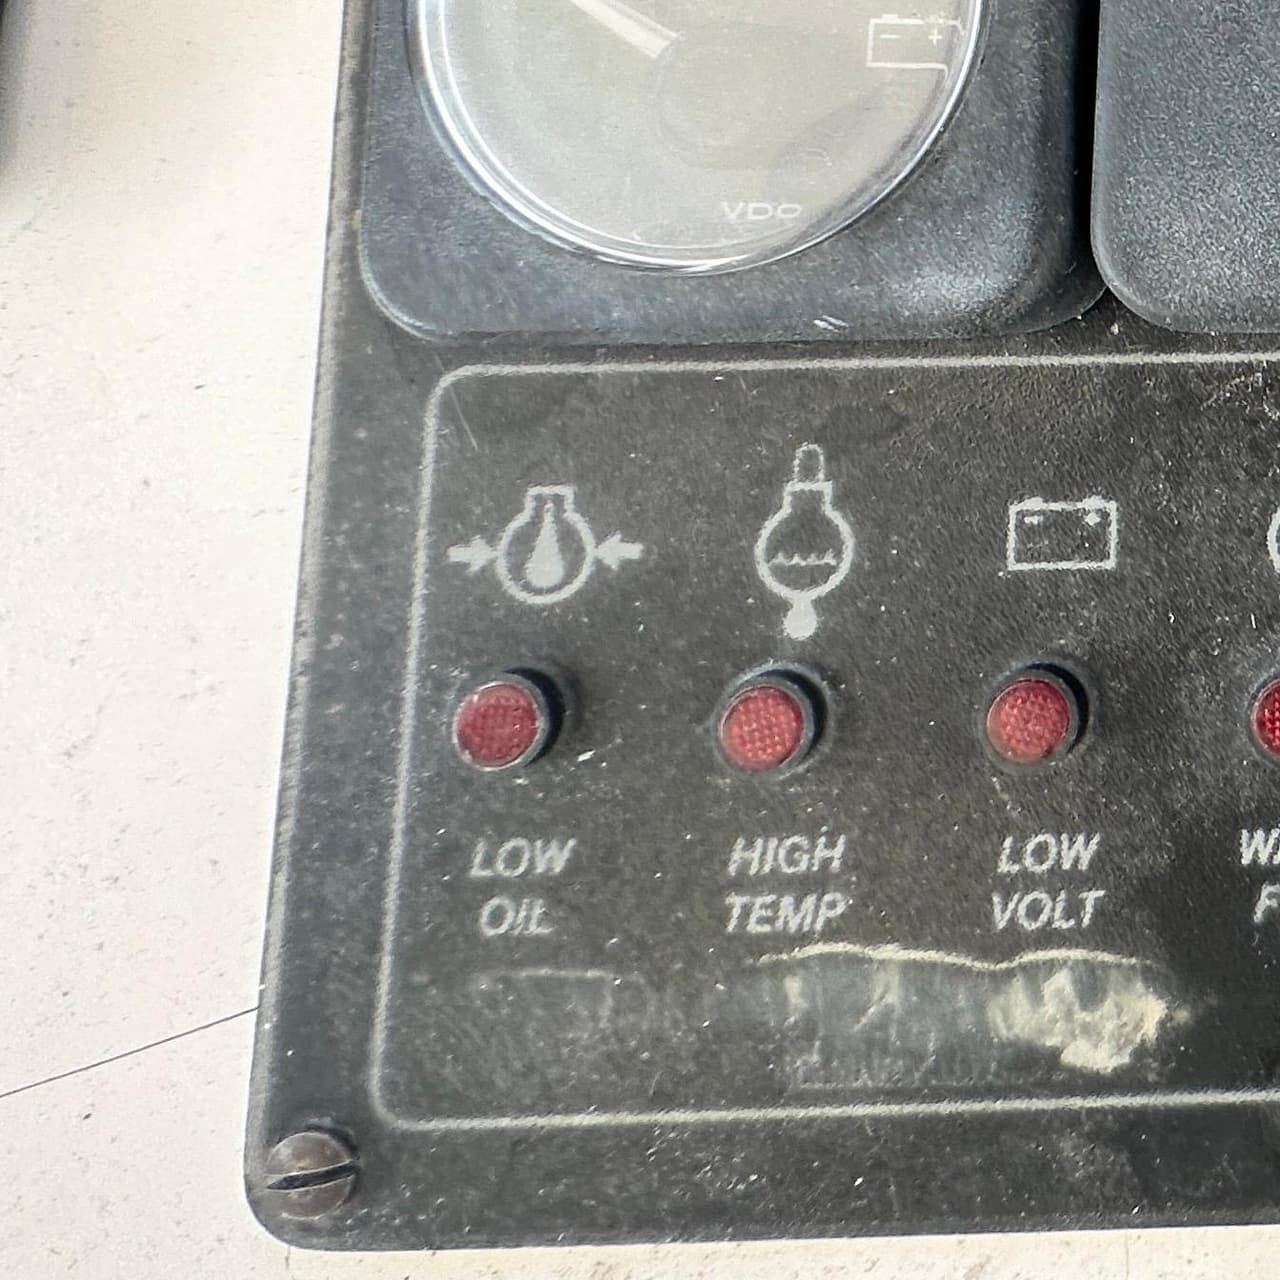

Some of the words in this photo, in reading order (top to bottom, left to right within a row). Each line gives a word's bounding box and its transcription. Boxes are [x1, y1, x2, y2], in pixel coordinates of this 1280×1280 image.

[721, 201, 803, 221] VDO
[468, 836, 575, 878] LOW
[727, 834, 847, 876] HIGH
[996, 833, 1100, 874] LOW
[477, 897, 556, 938] OIL
[724, 892, 850, 934] TEMP
[991, 889, 1106, 931] VOLT
